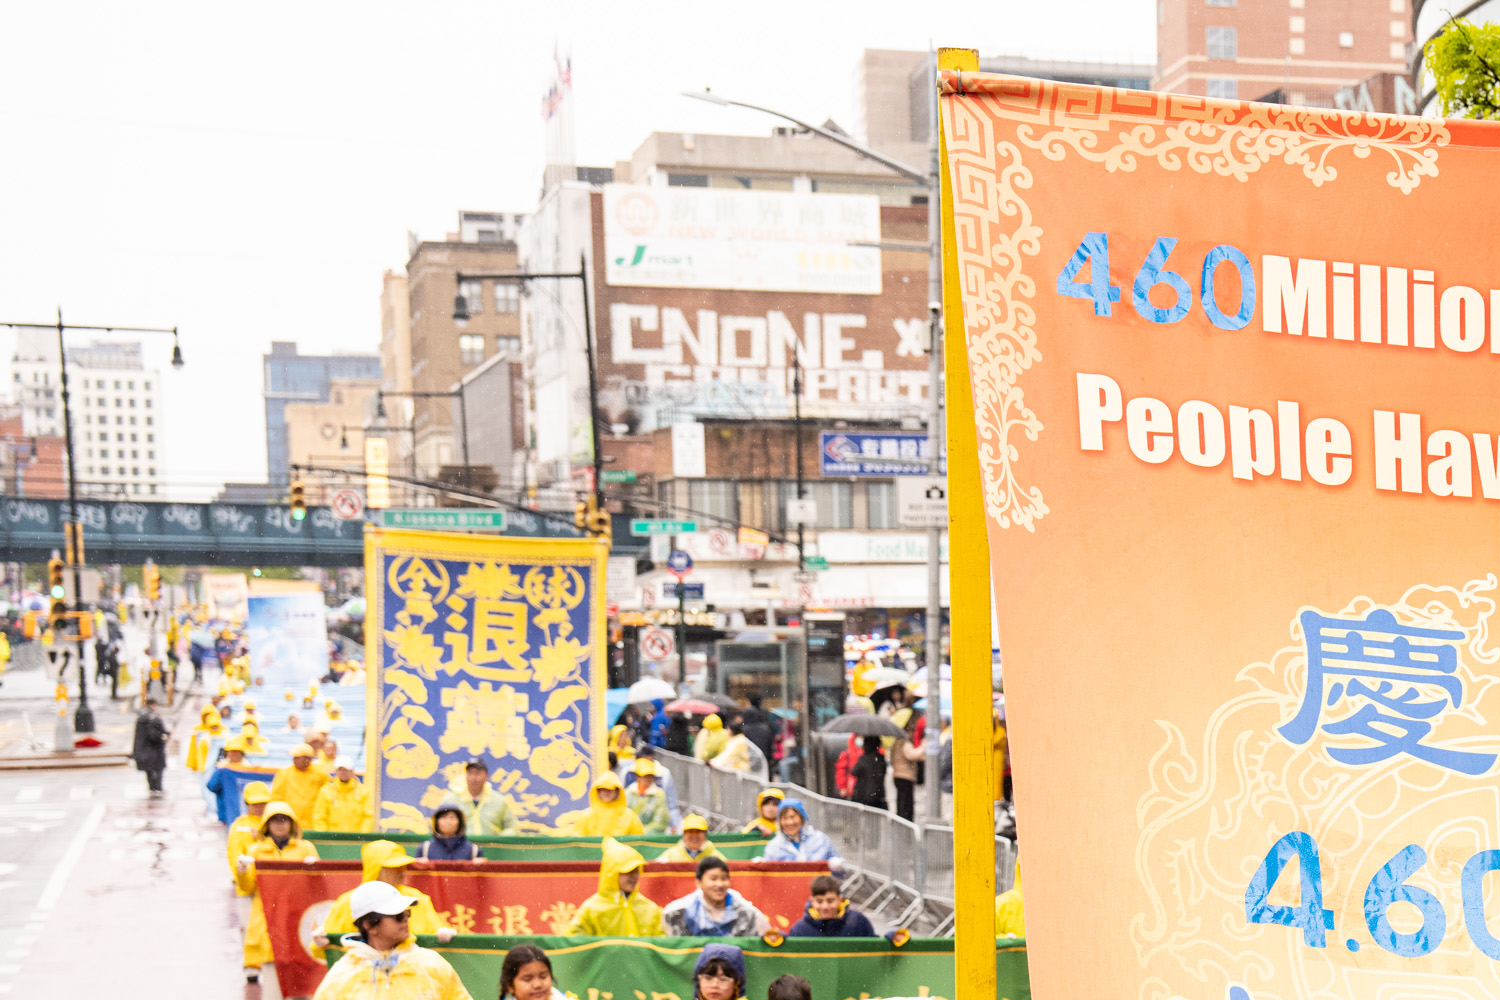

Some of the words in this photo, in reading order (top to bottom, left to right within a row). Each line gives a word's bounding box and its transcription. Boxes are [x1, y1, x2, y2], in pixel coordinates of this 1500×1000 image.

[1076, 372, 1353, 485] People
[393, 511, 455, 527] Kissena
[458, 511, 494, 526] Blvd
[866, 539, 901, 557] Food
